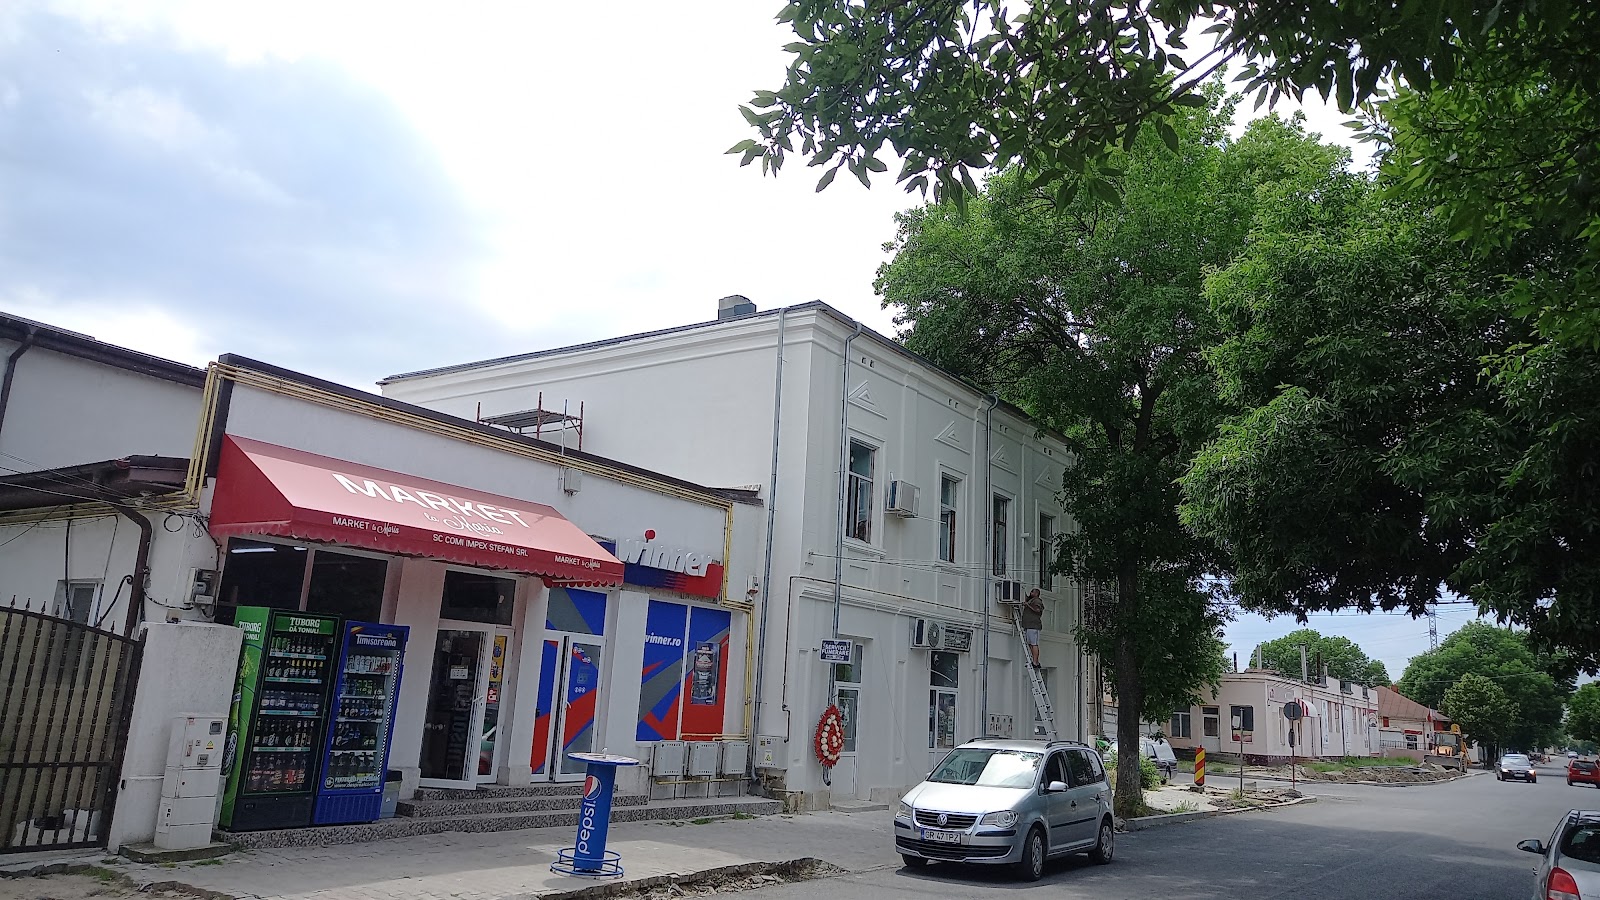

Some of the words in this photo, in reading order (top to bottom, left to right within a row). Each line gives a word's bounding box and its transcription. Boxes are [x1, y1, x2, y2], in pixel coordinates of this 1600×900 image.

[332, 473, 530, 528] MARKET
[332, 516, 370, 530] MARKET
[443, 515, 504, 537] Maria
[432, 533, 443, 543] SC
[445, 535, 464, 547] COMI
[466, 539, 488, 550] IMPEX
[489, 543, 515, 554] STEFAN
[516, 548, 529, 557] SRL
[616, 529, 712, 577] winner
[554, 555, 580, 565] MARKET
[239, 621, 262, 633] TUBORG
[290, 617, 320, 628] TUBORG
[578, 801, 596, 854] pepsi
